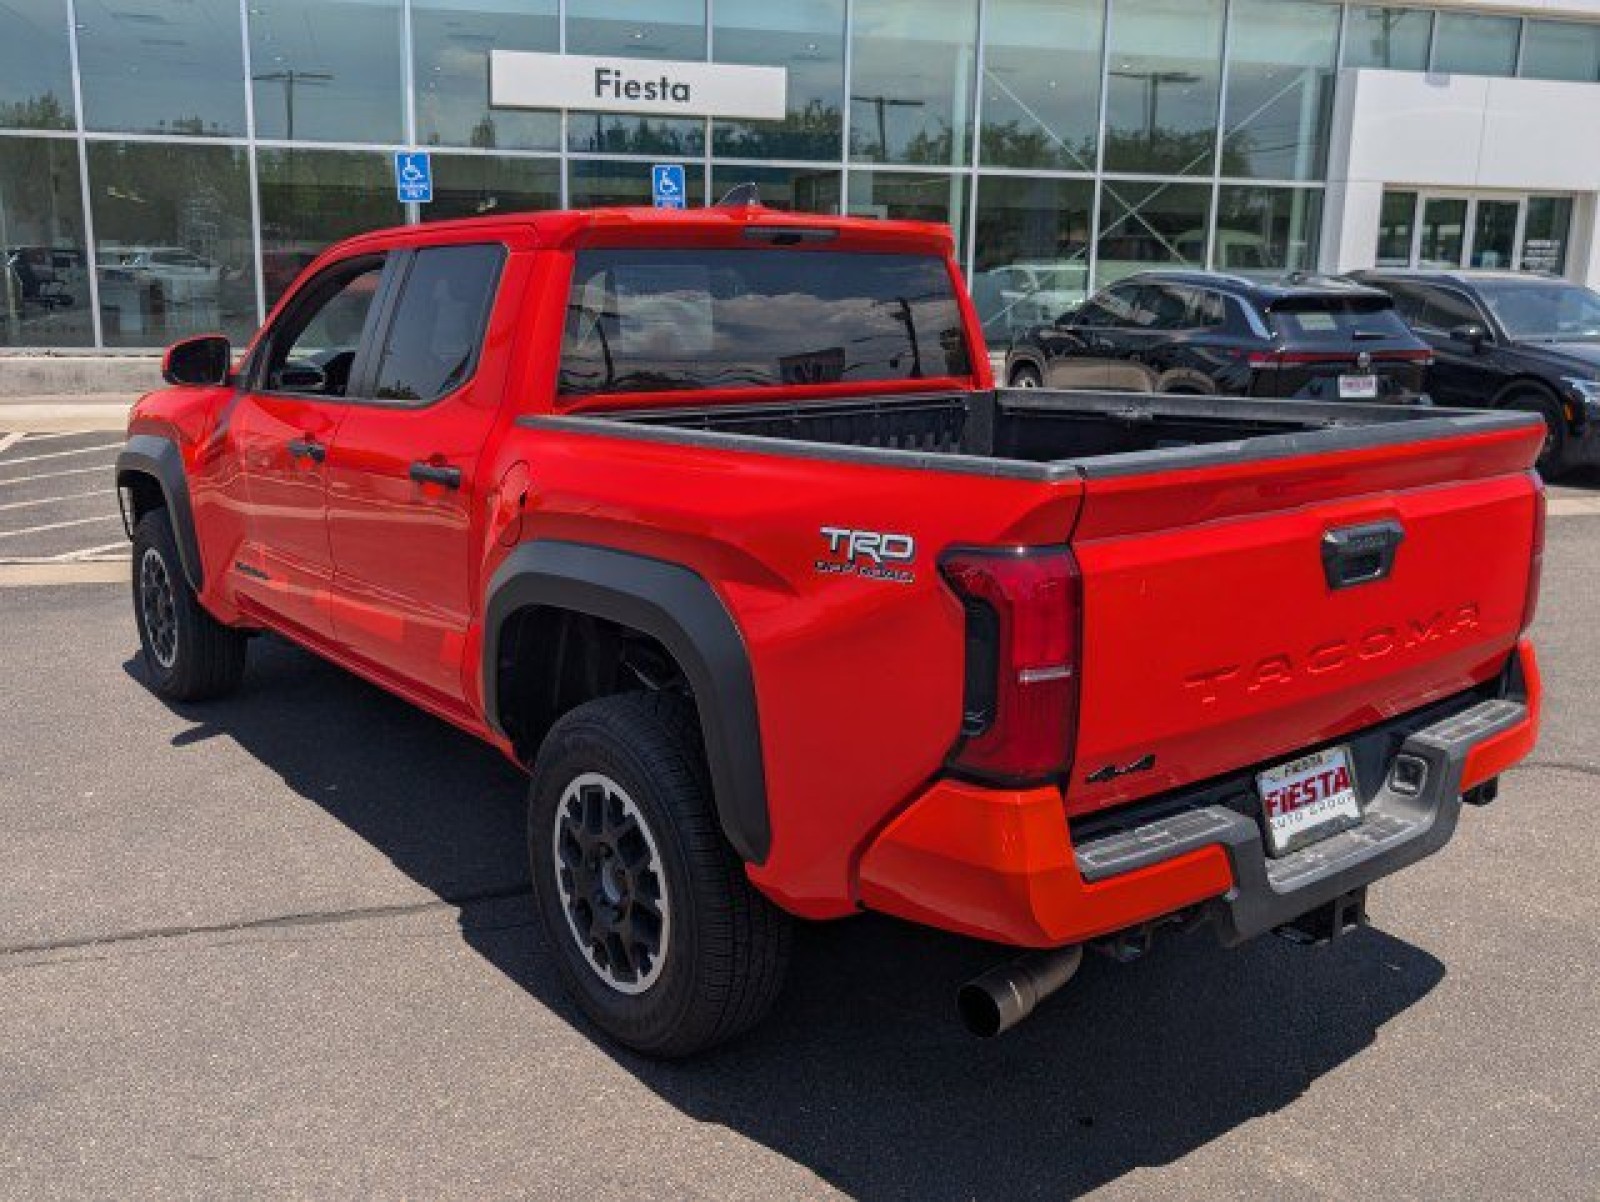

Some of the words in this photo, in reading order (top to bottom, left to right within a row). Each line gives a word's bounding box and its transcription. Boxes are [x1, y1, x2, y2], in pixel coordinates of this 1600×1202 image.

[594, 67, 690, 102] Fiesta
[820, 526, 915, 563] TRD
[1184, 602, 1480, 703] TACOMA
[1264, 767, 1351, 818] FIESTA
